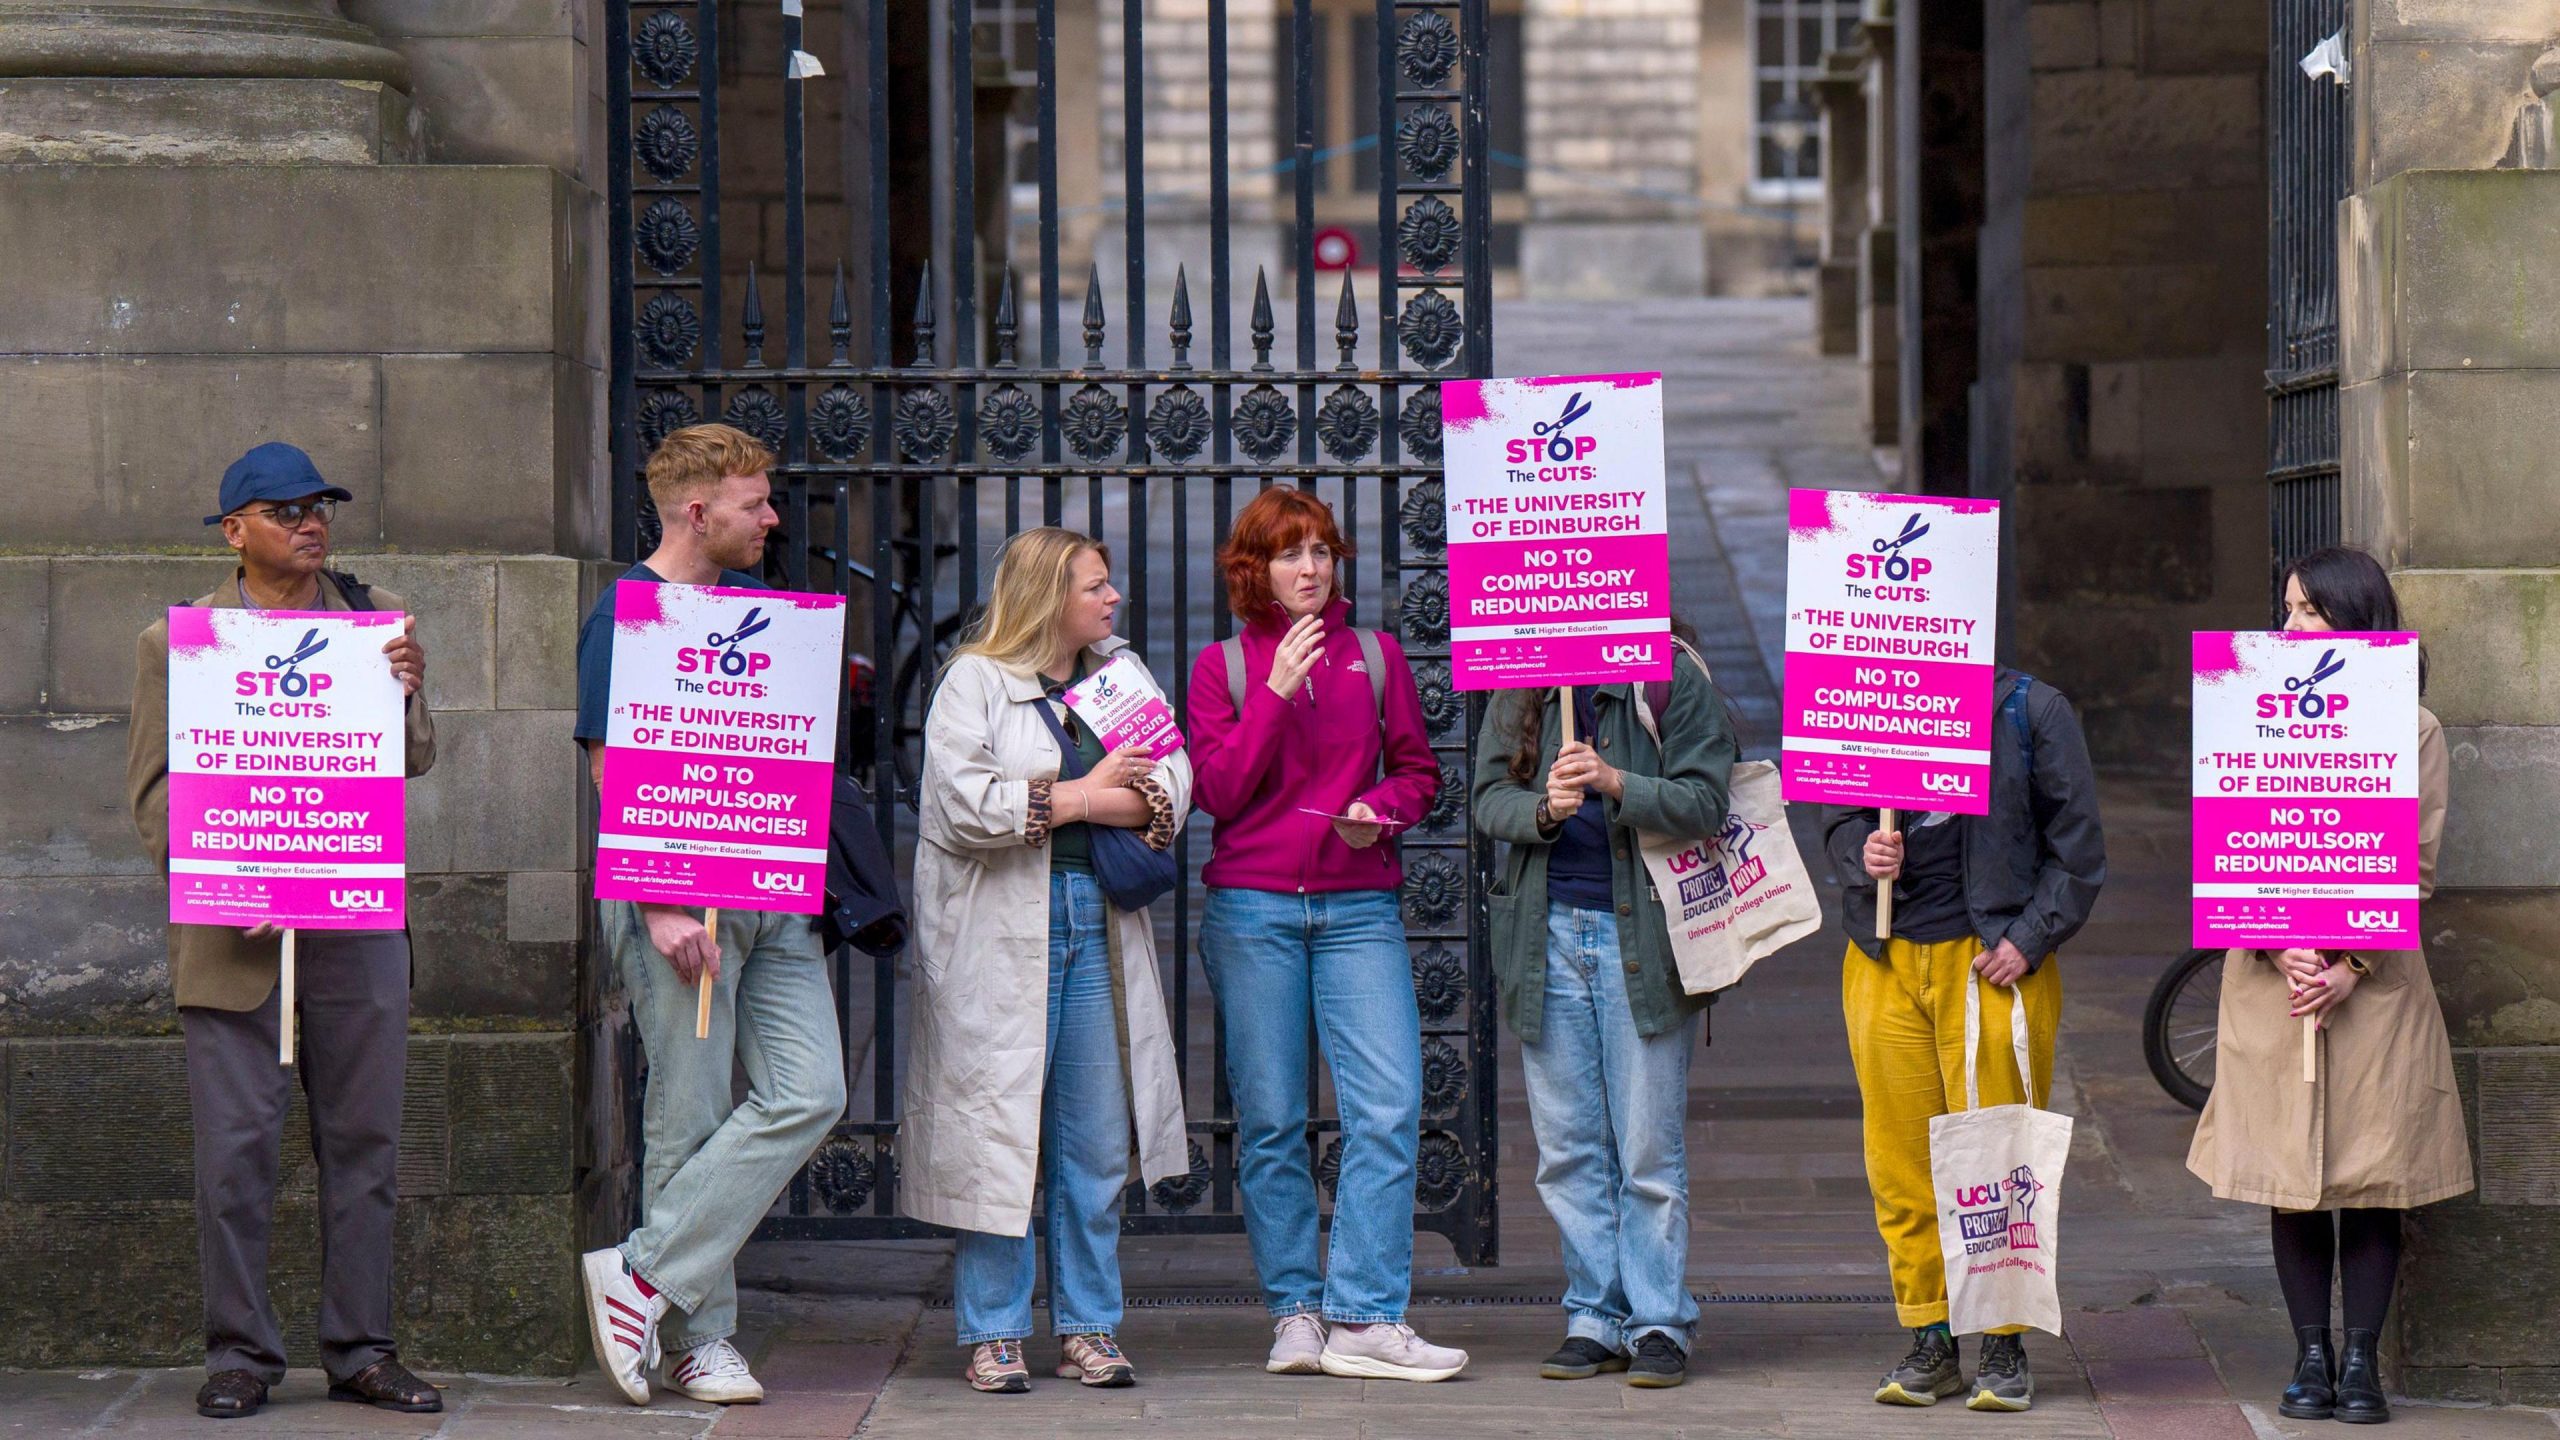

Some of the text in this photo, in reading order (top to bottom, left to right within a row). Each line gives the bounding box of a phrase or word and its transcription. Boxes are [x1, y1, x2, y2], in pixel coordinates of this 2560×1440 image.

[1505, 435, 1597, 465] STOP
[1505, 465, 1597, 483] The CUTS:
[1450, 490, 1646, 516] at THE UNIVERSITY
[1471, 513, 1641, 538] OF EDINBURGH
[1523, 548, 1593, 568] NO TO
[1845, 552, 1933, 583] STOP
[1481, 568, 1636, 593] COMPULSORY
[1470, 591, 1649, 616] REDUNDANCIES!
[1844, 583, 1931, 604] The CUTS:
[1514, 624, 1608, 636] SAVE Higher Education
[1791, 608, 1977, 636] at THE UNIVERSITY
[1808, 631, 1969, 659] OF EDINBURGH
[675, 646, 772, 678] STOP
[235, 669, 333, 698] STOP
[674, 677, 769, 699] The CUTS:
[1855, 667, 1921, 689] NO TO
[1092, 683, 1118, 706] STOP
[1814, 687, 1961, 714] COMPULSORY
[2255, 691, 2350, 720] STOP
[234, 701, 332, 719] The CUTS:
[613, 702, 817, 733] at THE UNIVERSITY
[1095, 688, 1143, 727] THE UNIVERSITY
[1102, 696, 1147, 733] OF EDINBURGH
[1117, 722, 1134, 738] NO
[1132, 712, 1147, 725] TO
[1141, 713, 1166, 735] CUTS
[1802, 709, 1971, 739] REDUNDANCIES!
[2255, 723, 2348, 740] The CUTS:
[175, 728, 383, 749] at THE UNIVERSITY
[632, 727, 808, 757] OF EDINBURGH
[1841, 743, 1930, 757] SAVE Higher Education
[196, 752, 376, 773] OF EDINBURGH
[2198, 752, 2398, 770] at THE UNIVERSITY
[682, 763, 754, 785] NO TO
[2218, 775, 2392, 793] OF EDINBURGH
[249, 785, 325, 806] NO TO
[636, 783, 797, 812] COMPULSORY
[203, 807, 370, 829] COMPULSORY
[622, 806, 807, 837] REDUNDANCIES!
[2270, 808, 2341, 826] NO TO
[191, 830, 383, 853] REDUNDANCIES!
[664, 841, 762, 856] SAVE Higher Education
[2226, 831, 2385, 850] COMPULSORY
[236, 865, 337, 875] SAVE Higher Education
[1732, 858, 1761, 892] NOW
[2214, 854, 2397, 874] REDUNDANCIES!
[1682, 864, 1725, 902] PROTECT
[2257, 887, 2354, 896] SAVE Higher Education
[1683, 887, 1733, 921] EDUCATION
[1687, 919, 1726, 940] University
[1734, 895, 1764, 916] College
[1764, 882, 1792, 900] Union
[1963, 1209, 2007, 1237] PROTECT
[1965, 1235, 2008, 1255] EDUCATION
[1967, 1263, 1996, 1276] University
[2005, 1257, 2033, 1270] College
